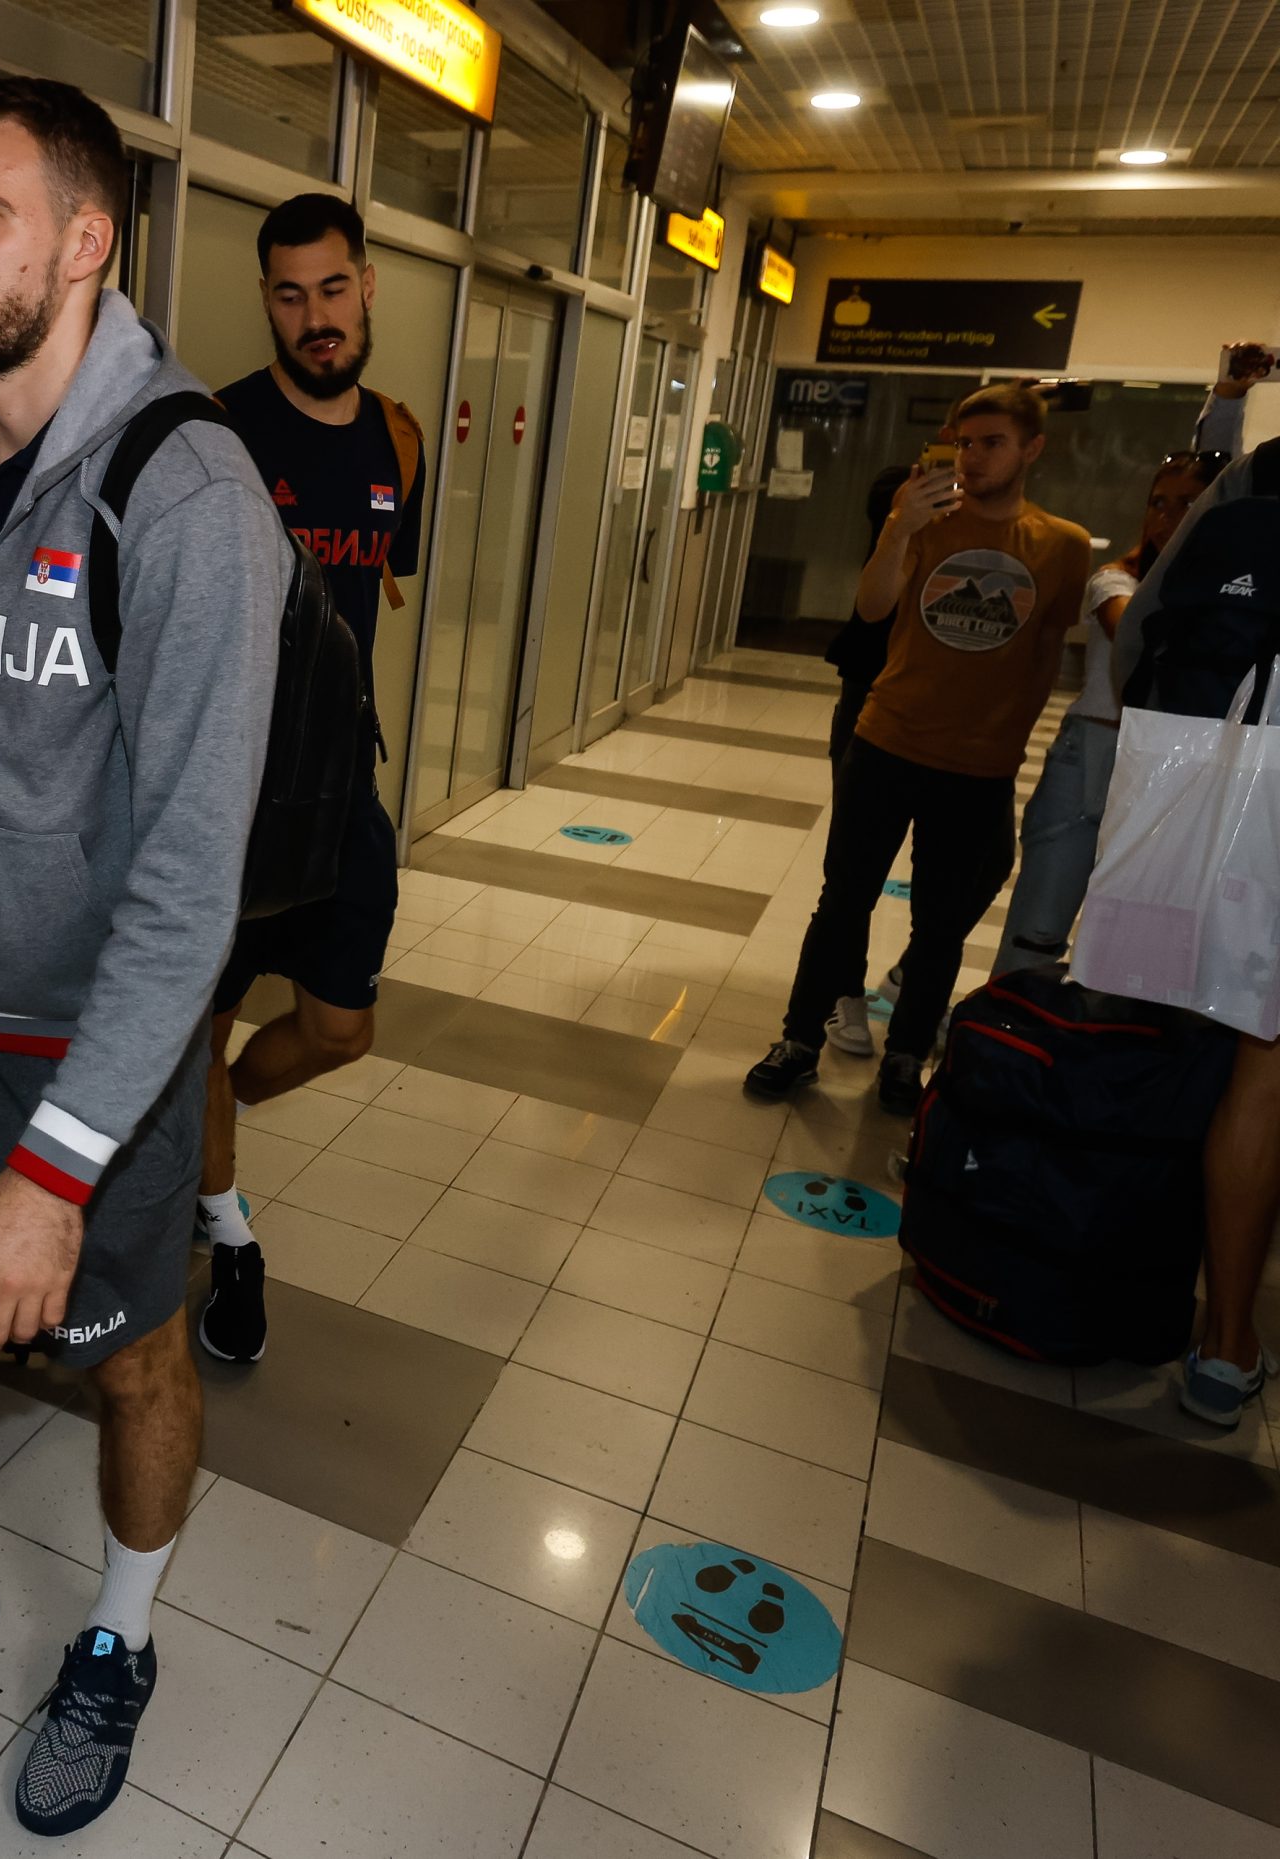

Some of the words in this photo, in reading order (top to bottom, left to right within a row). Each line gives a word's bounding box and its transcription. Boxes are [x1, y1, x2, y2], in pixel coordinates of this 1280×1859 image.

[402, 32, 417, 58] no
[418, 43, 446, 84] entry
[446, 20, 483, 65] pristup
[1220, 583, 1257, 597] PEAK
[797, 1200, 874, 1232] TAXI
